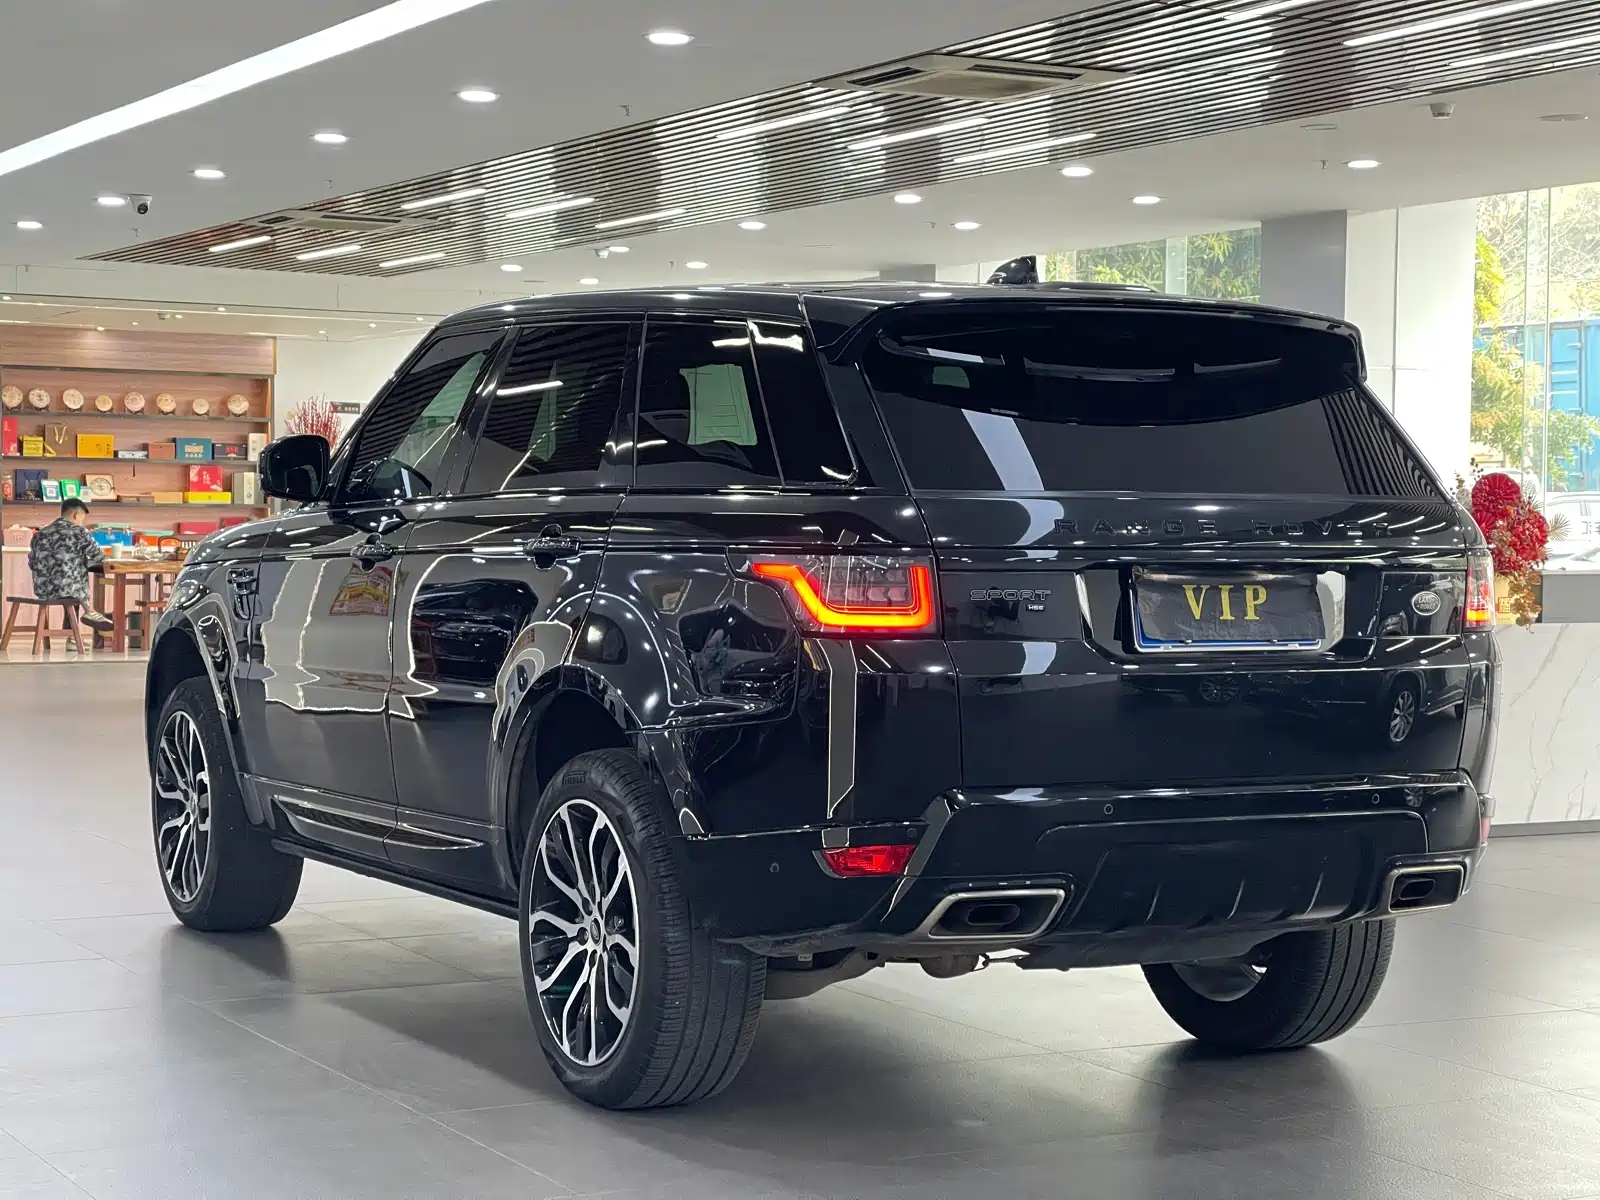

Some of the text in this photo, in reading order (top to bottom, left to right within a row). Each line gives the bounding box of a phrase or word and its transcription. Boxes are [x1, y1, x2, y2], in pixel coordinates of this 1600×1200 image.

[1054, 518, 1393, 537] RANGE ROVER
[970, 589, 1052, 601] SPORT
[1182, 584, 1267, 620] VIP
